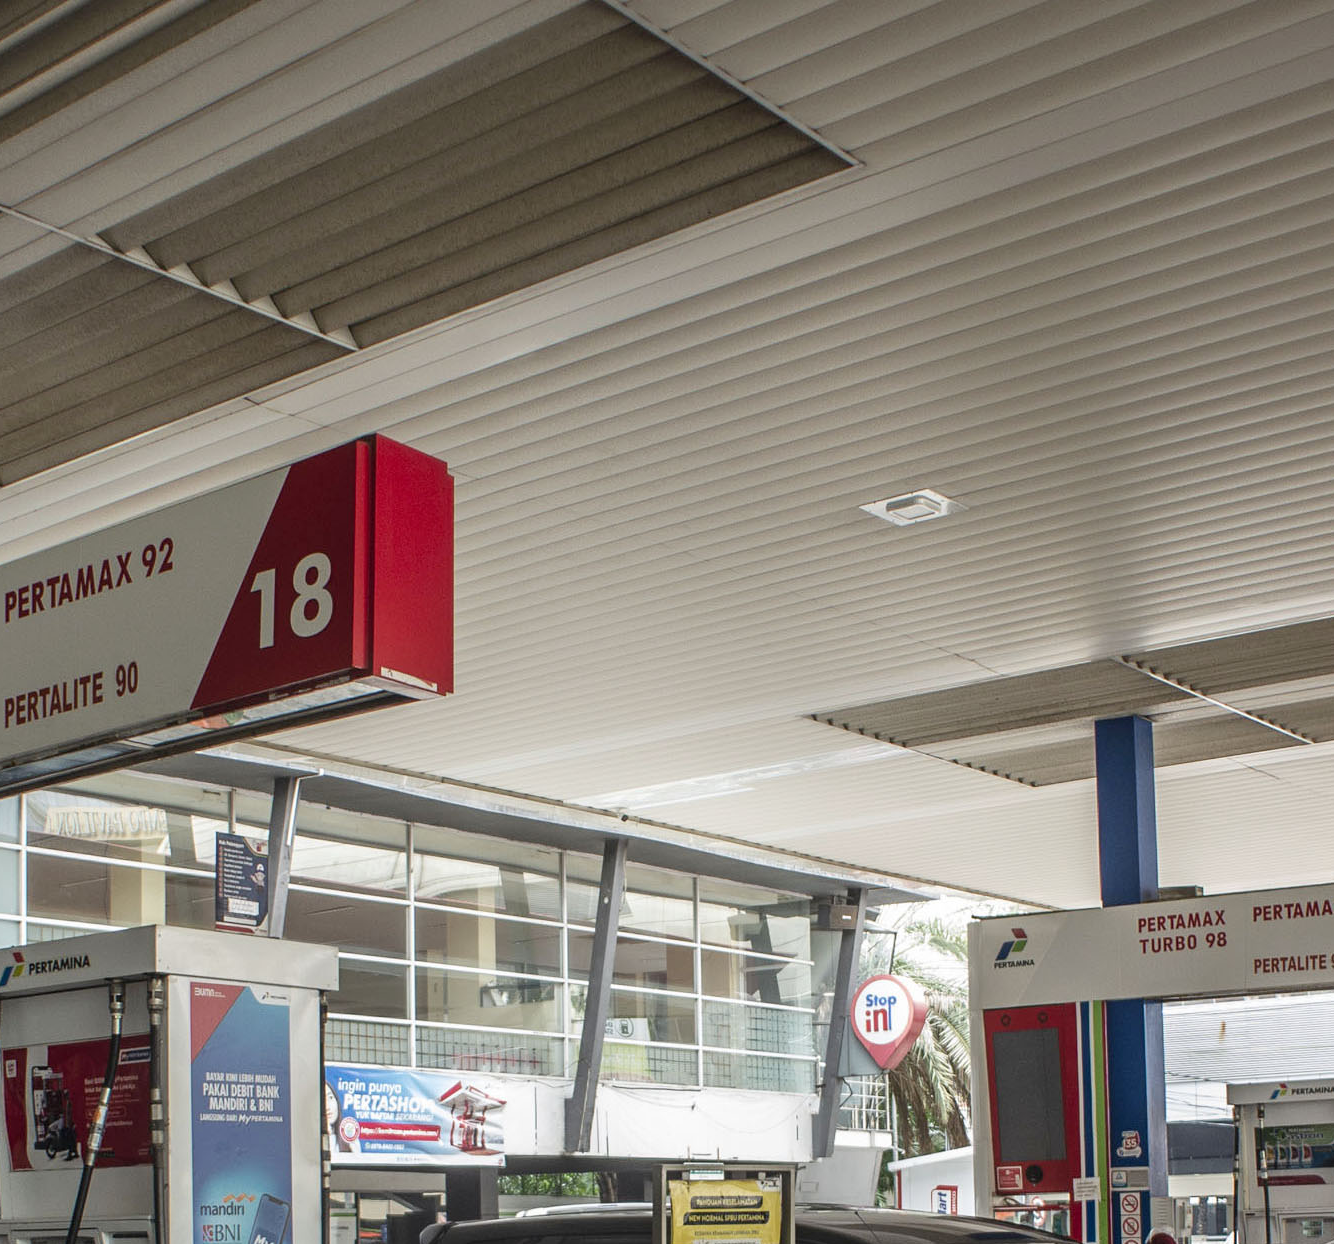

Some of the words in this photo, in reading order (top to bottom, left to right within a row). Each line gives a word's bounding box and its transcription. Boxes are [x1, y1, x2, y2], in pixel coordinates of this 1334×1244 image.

[4, 551, 134, 622] PERTAMAX
[142, 537, 174, 577] 92
[251, 552, 334, 650] 18
[3, 672, 104, 728] PERTALITE
[114, 661, 139, 695] 90
[1138, 910, 1226, 934] PERTAMAX
[1140, 935, 1197, 955] TURBO
[1205, 932, 1228, 950] 98
[28, 954, 91, 976] PERTAMINA
[994, 959, 1035, 969] PERTAMINA
[1253, 955, 1328, 976] PERTALITE
[866, 993, 897, 1019] Stop
[865, 1010, 888, 1033] in
[206, 1072, 225, 1082] BAYAR
[239, 1073, 254, 1083] LEBIH
[255, 1074, 276, 1084] MUDAH
[338, 1078, 366, 1094] ingin
[368, 1082, 402, 1097] punya
[203, 1082, 229, 1097] PAKAI
[231, 1083, 254, 1098] DEBIT
[256, 1085, 280, 1099] BANK
[209, 1096, 247, 1111] MANDIRI
[250, 1098, 257, 1112] &
[259, 1099, 274, 1112] BNI
[200, 1201, 245, 1217] mandiri
[214, 1224, 241, 1242] BNI
